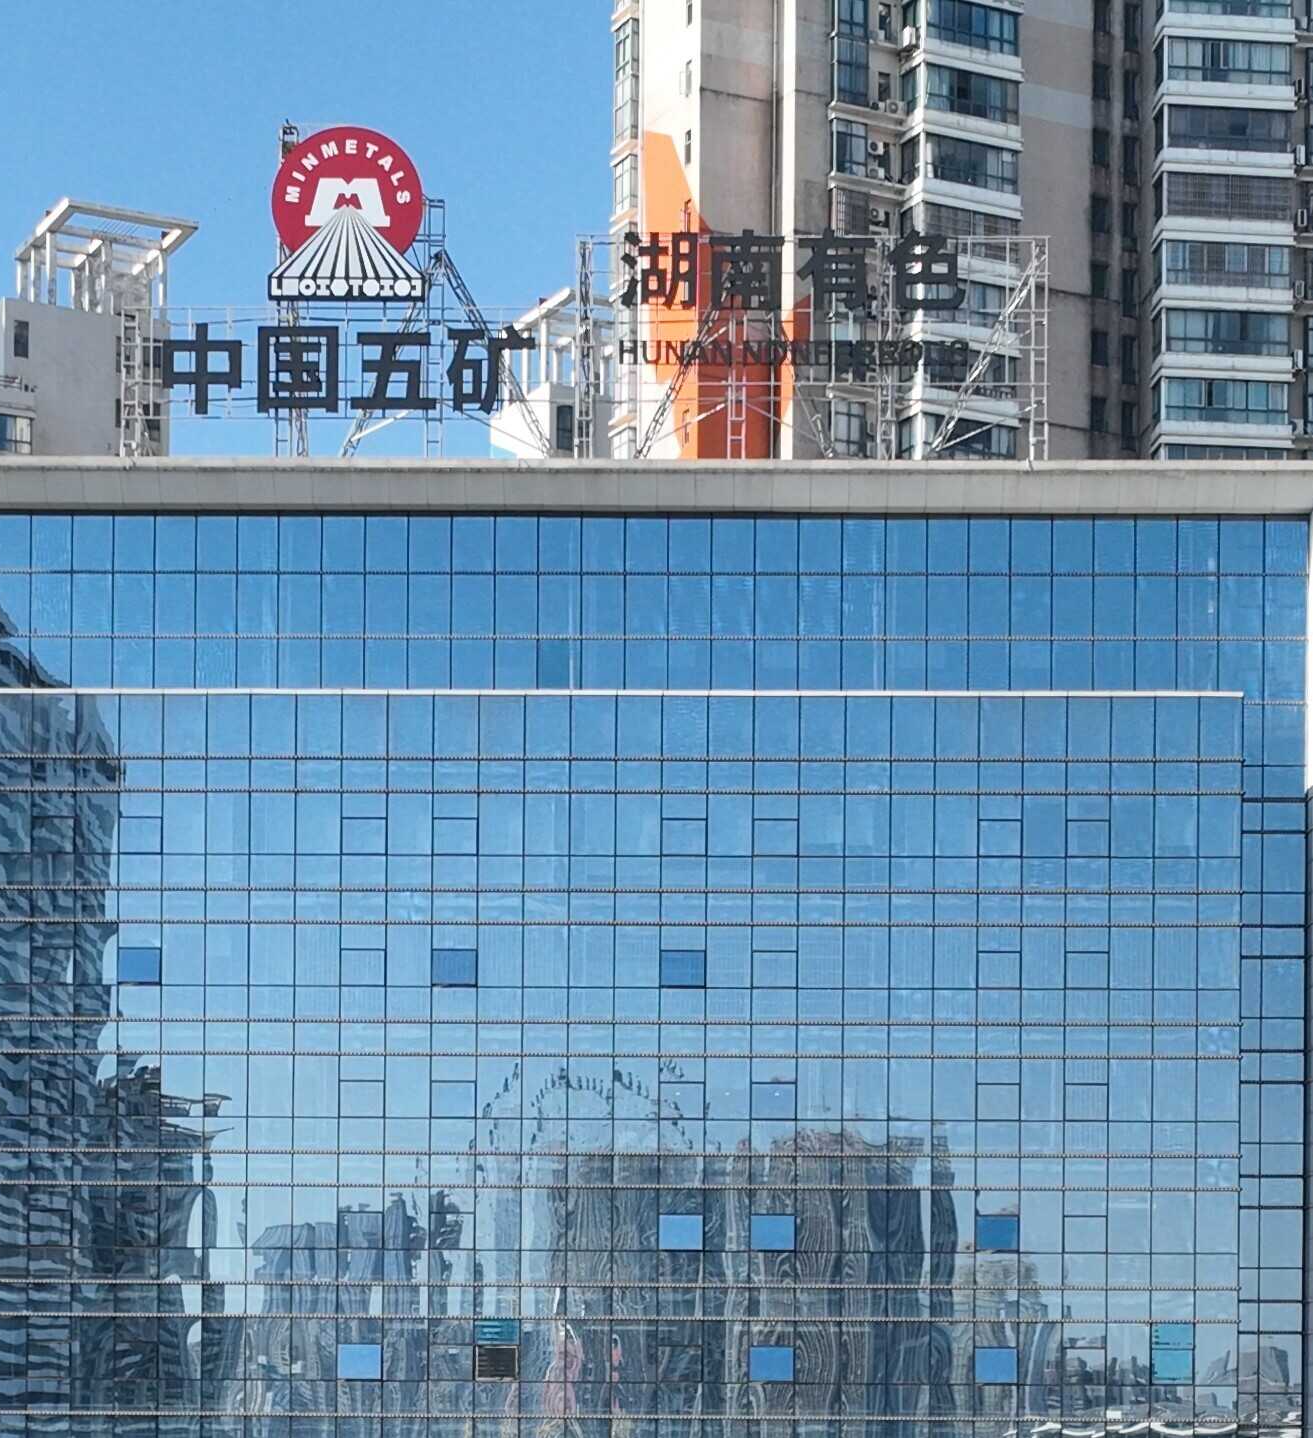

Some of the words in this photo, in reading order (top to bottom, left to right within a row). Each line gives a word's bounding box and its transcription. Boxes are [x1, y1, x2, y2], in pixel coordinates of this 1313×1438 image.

[285, 139, 411, 205] MINMETALS
[620, 228, 966, 310] 湖南有色
[163, 322, 536, 416] 中国五矿
[618, 340, 733, 366] HUNAN
